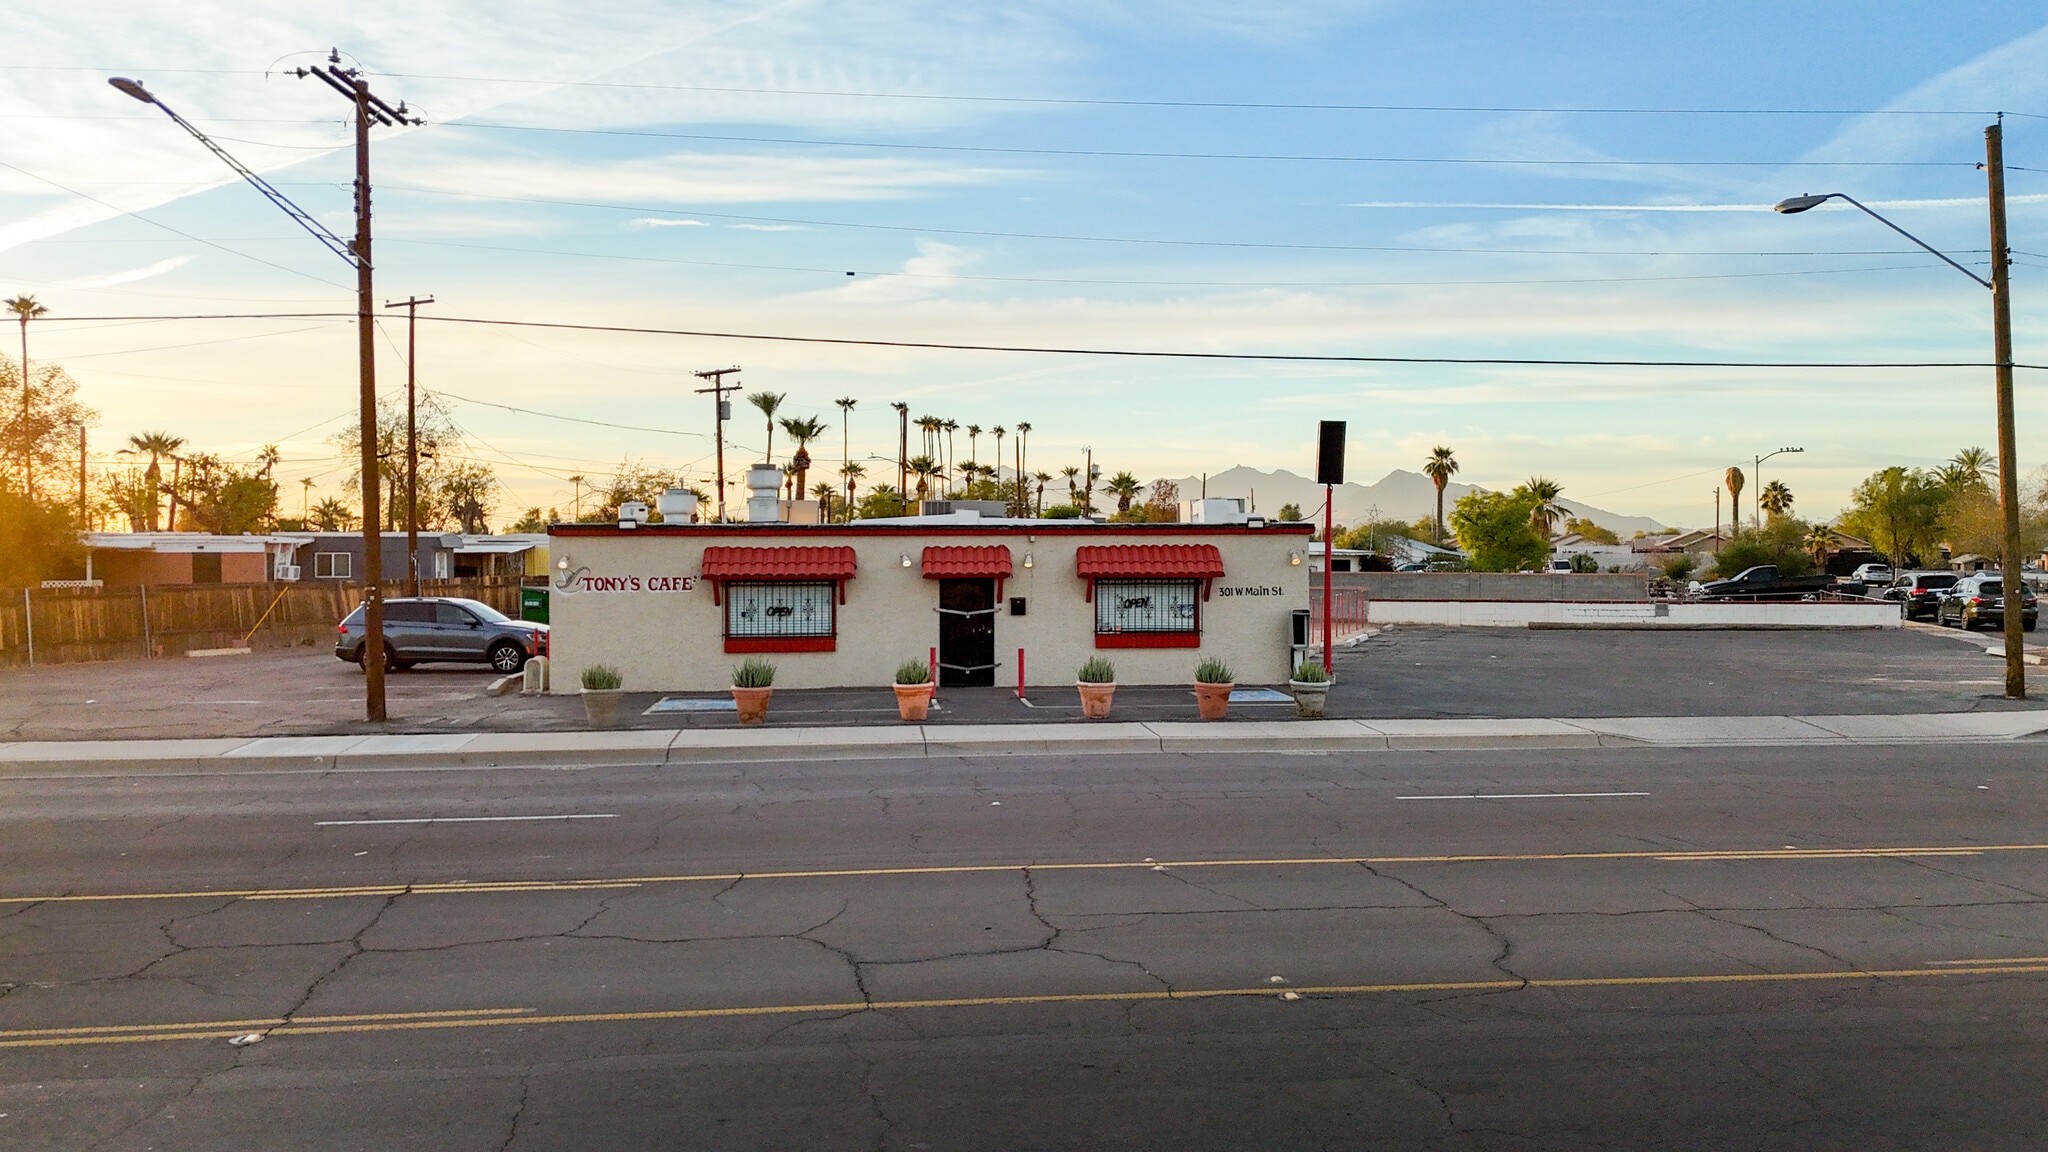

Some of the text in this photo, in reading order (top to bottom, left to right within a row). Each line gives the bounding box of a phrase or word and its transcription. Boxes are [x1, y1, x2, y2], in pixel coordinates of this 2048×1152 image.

[582, 575, 640, 591] TONY'S
[1219, 587, 1233, 597] 301
[1235, 587, 1244, 596] W
[1245, 586, 1270, 596] Main
[1124, 597, 1148, 609] OPEN
[766, 606, 794, 617] OPEN
